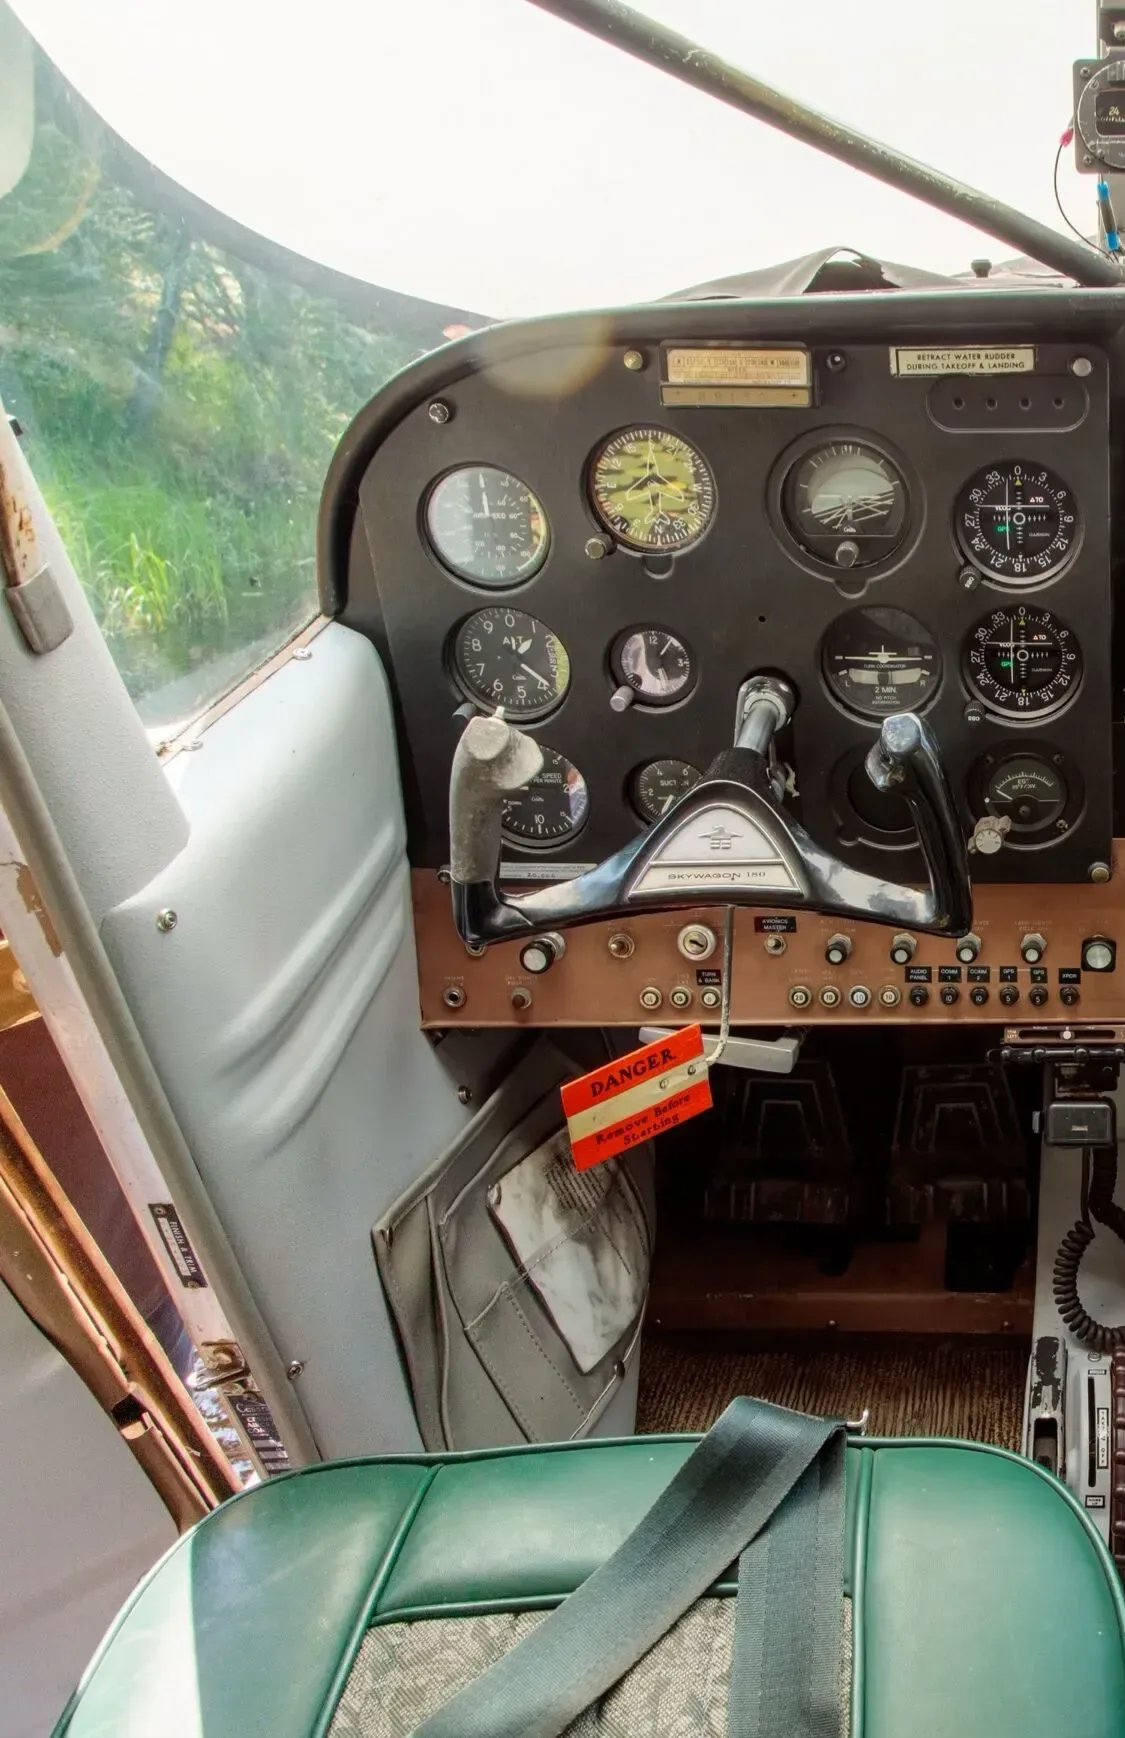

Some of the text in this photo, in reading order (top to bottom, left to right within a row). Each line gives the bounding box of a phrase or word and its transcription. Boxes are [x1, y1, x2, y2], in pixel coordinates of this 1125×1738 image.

[1108, 106, 1120, 116] 24
[917, 353, 950, 361] RETRACT
[988, 361, 1025, 369] LANDING
[1014, 465, 1021, 475] 0
[986, 471, 1000, 485] 33
[1038, 472, 1047, 481] 3
[969, 488, 982, 503] 30
[1057, 490, 1066, 499] 6
[965, 514, 975, 527] 27
[1064, 515, 1074, 523] 9
[655, 525, 663, 533] N
[971, 537, 985, 551] 24
[1056, 538, 1069, 551] 12
[990, 556, 1005, 568] 21
[1014, 563, 1027, 573] 18
[1038, 556, 1051, 568] 15
[992, 611, 1005, 624] 33
[1019, 607, 1025, 616] 0
[1043, 613, 1051, 622] 3
[483, 620, 493, 634] 9
[504, 614, 515, 628] 0
[532, 620, 536, 633] 1
[649, 636, 658, 644] 12
[975, 628, 988, 641] 30
[1060, 630, 1069, 639] 6
[471, 638, 482, 652] 8
[545, 634, 555, 648] 2
[677, 658, 684, 667] 3
[970, 651, 980, 663] 27
[476, 663, 485, 676] 7
[493, 679, 503, 691] 6
[976, 673, 990, 686] 24
[1058, 674, 1070, 686] 12
[516, 685, 526, 698] 5
[995, 690, 1008, 702] 21
[1041, 691, 1054, 702] 15
[1018, 697, 1030, 706] 18
[683, 768, 688, 776] 6
[647, 788, 654, 796] 2
[534, 814, 545, 825] 10
[668, 872, 741, 880] SKYWAGON
[856, 994, 863, 1002] 10
[590, 1048, 677, 1098] DANGER
[595, 1093, 691, 1145] Remove Before
[623, 1113, 680, 1145] Starting
[170, 1222, 184, 1244] FINISH
[185, 1256, 197, 1273] TRIM
